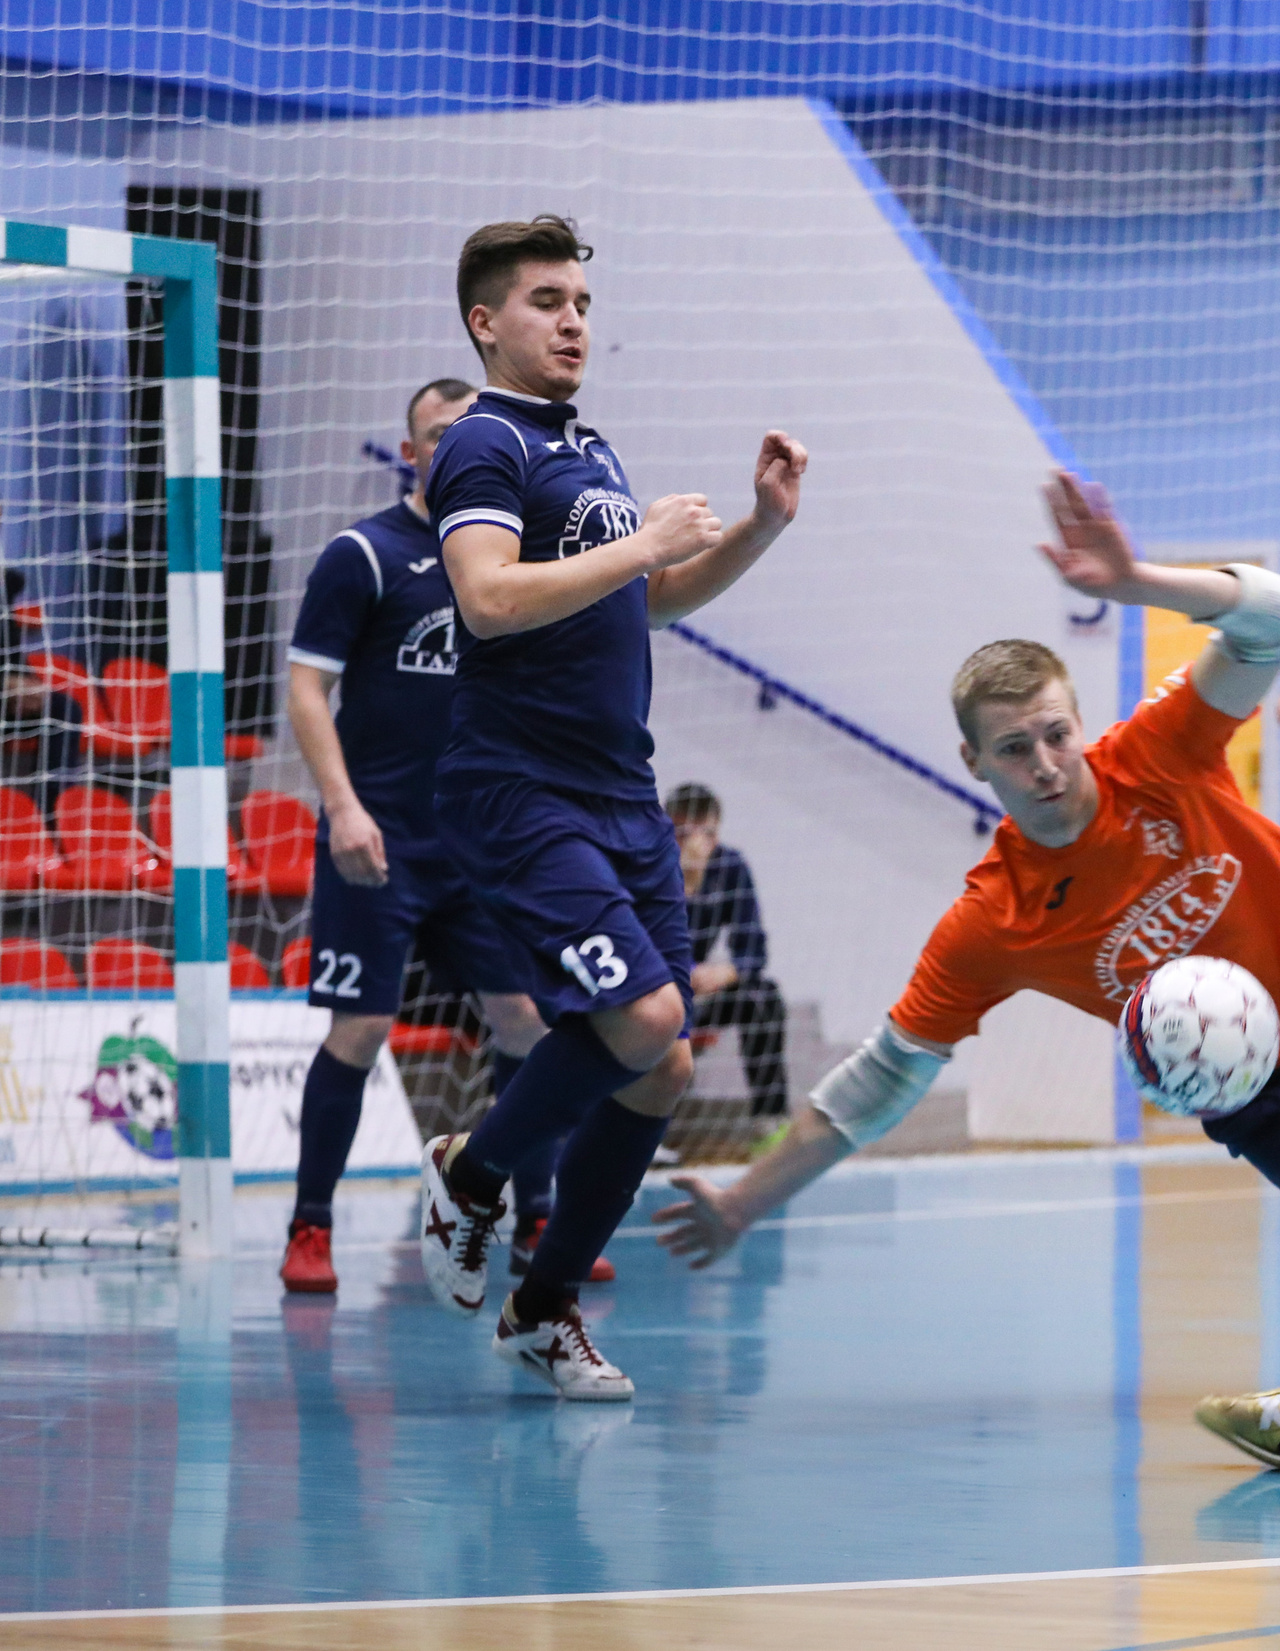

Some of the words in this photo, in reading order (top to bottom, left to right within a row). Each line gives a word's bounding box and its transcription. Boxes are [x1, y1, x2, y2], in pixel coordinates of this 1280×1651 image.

[1128, 892, 1204, 966] 1814
[313, 949, 362, 998] 22
[560, 934, 628, 997] 13
